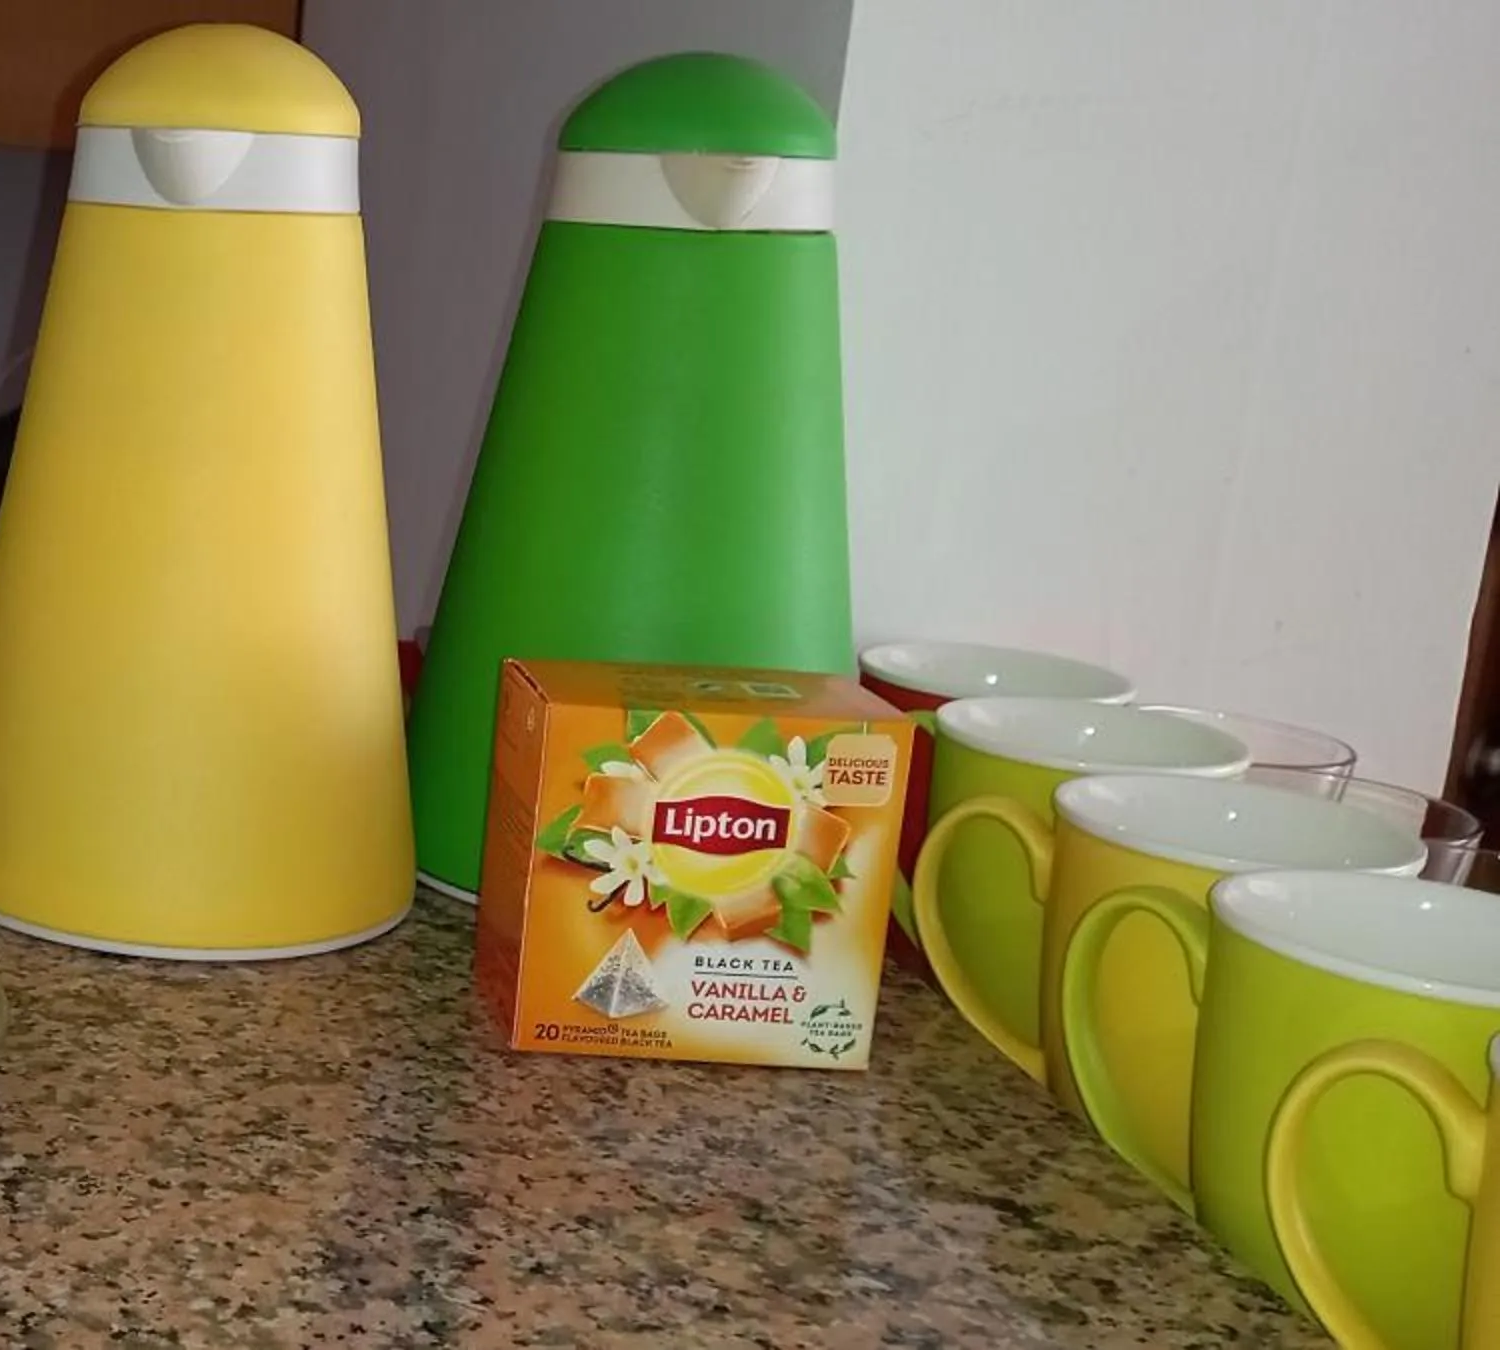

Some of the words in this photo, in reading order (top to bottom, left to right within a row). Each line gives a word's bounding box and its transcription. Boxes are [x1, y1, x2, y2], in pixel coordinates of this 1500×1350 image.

[829, 757, 889, 769] DELICIOUS
[828, 769, 886, 785] TASTE
[664, 807, 777, 843] Lipton
[695, 956, 753, 970] BLACK
[762, 959, 794, 971] TEA
[691, 980, 788, 1002] VANILLA
[792, 985, 807, 1003] &
[687, 1002, 794, 1024] CARAMEL
[534, 1024, 560, 1041] 20
